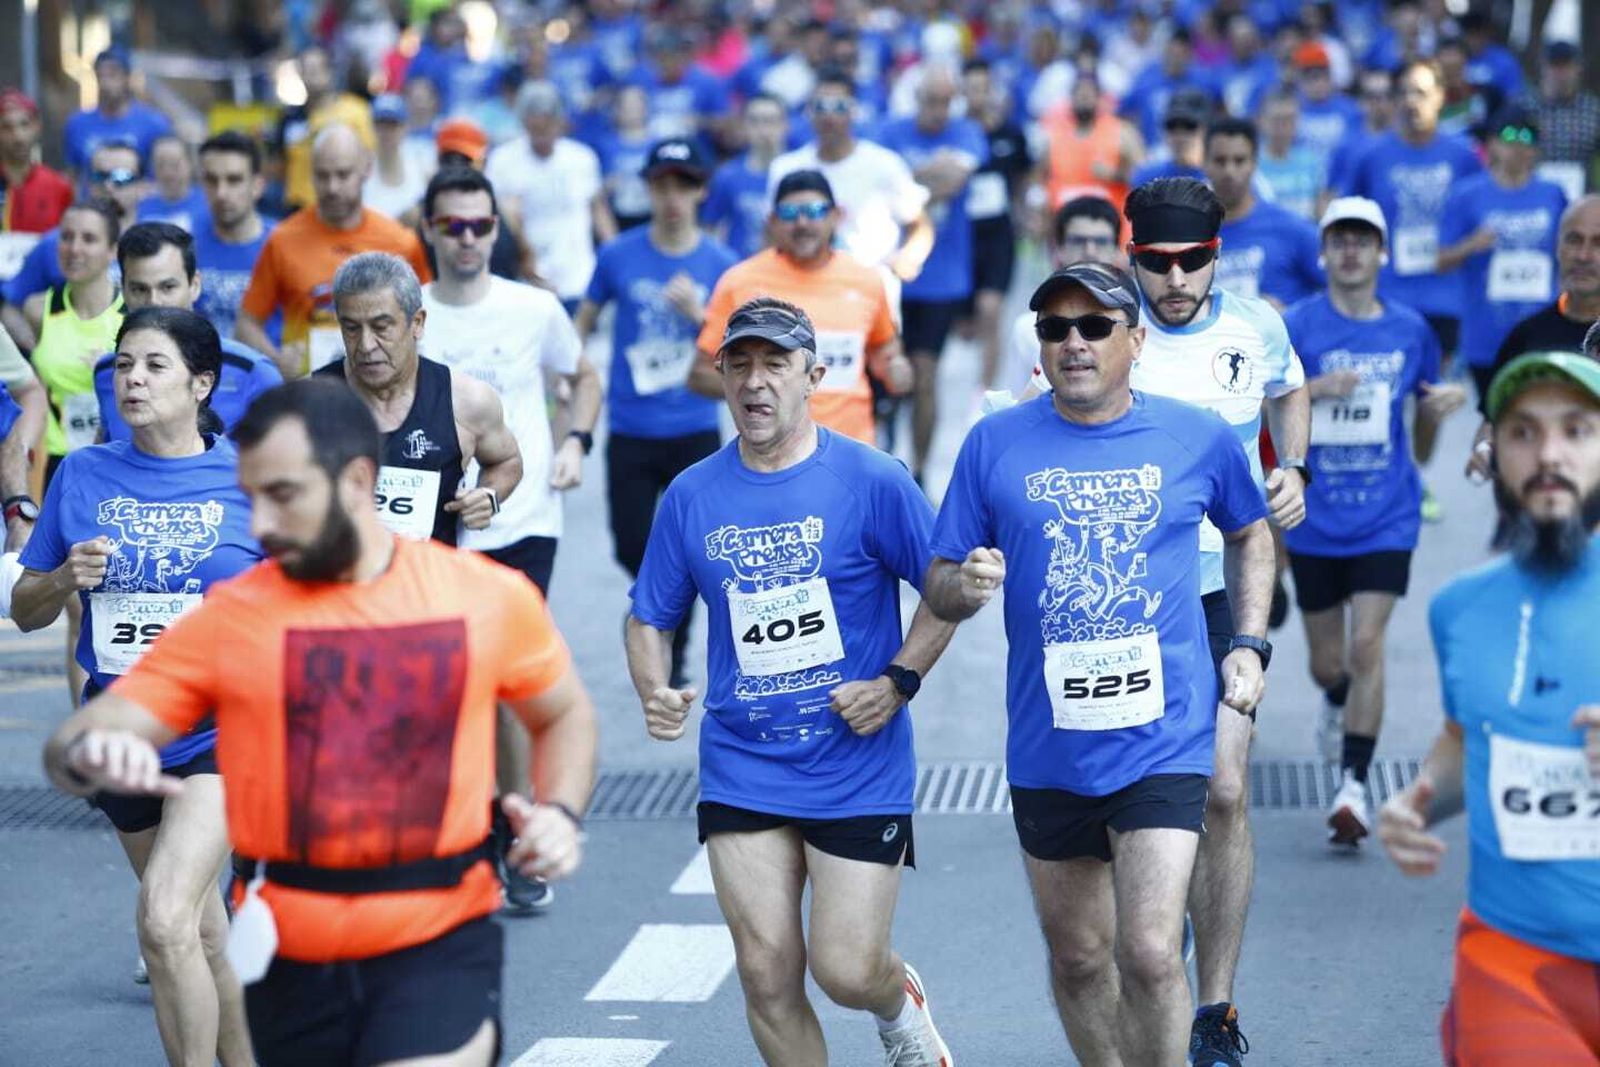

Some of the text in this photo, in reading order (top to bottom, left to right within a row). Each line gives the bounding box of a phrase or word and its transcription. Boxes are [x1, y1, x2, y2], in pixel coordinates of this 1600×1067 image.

[1046, 468, 1141, 496] Carrera
[114, 498, 203, 521] Carrera
[1064, 488, 1151, 511] Prensa
[720, 526, 803, 554] Carrera
[739, 541, 810, 568] Prensa
[742, 610, 825, 645] 405
[1063, 669, 1151, 699] 525
